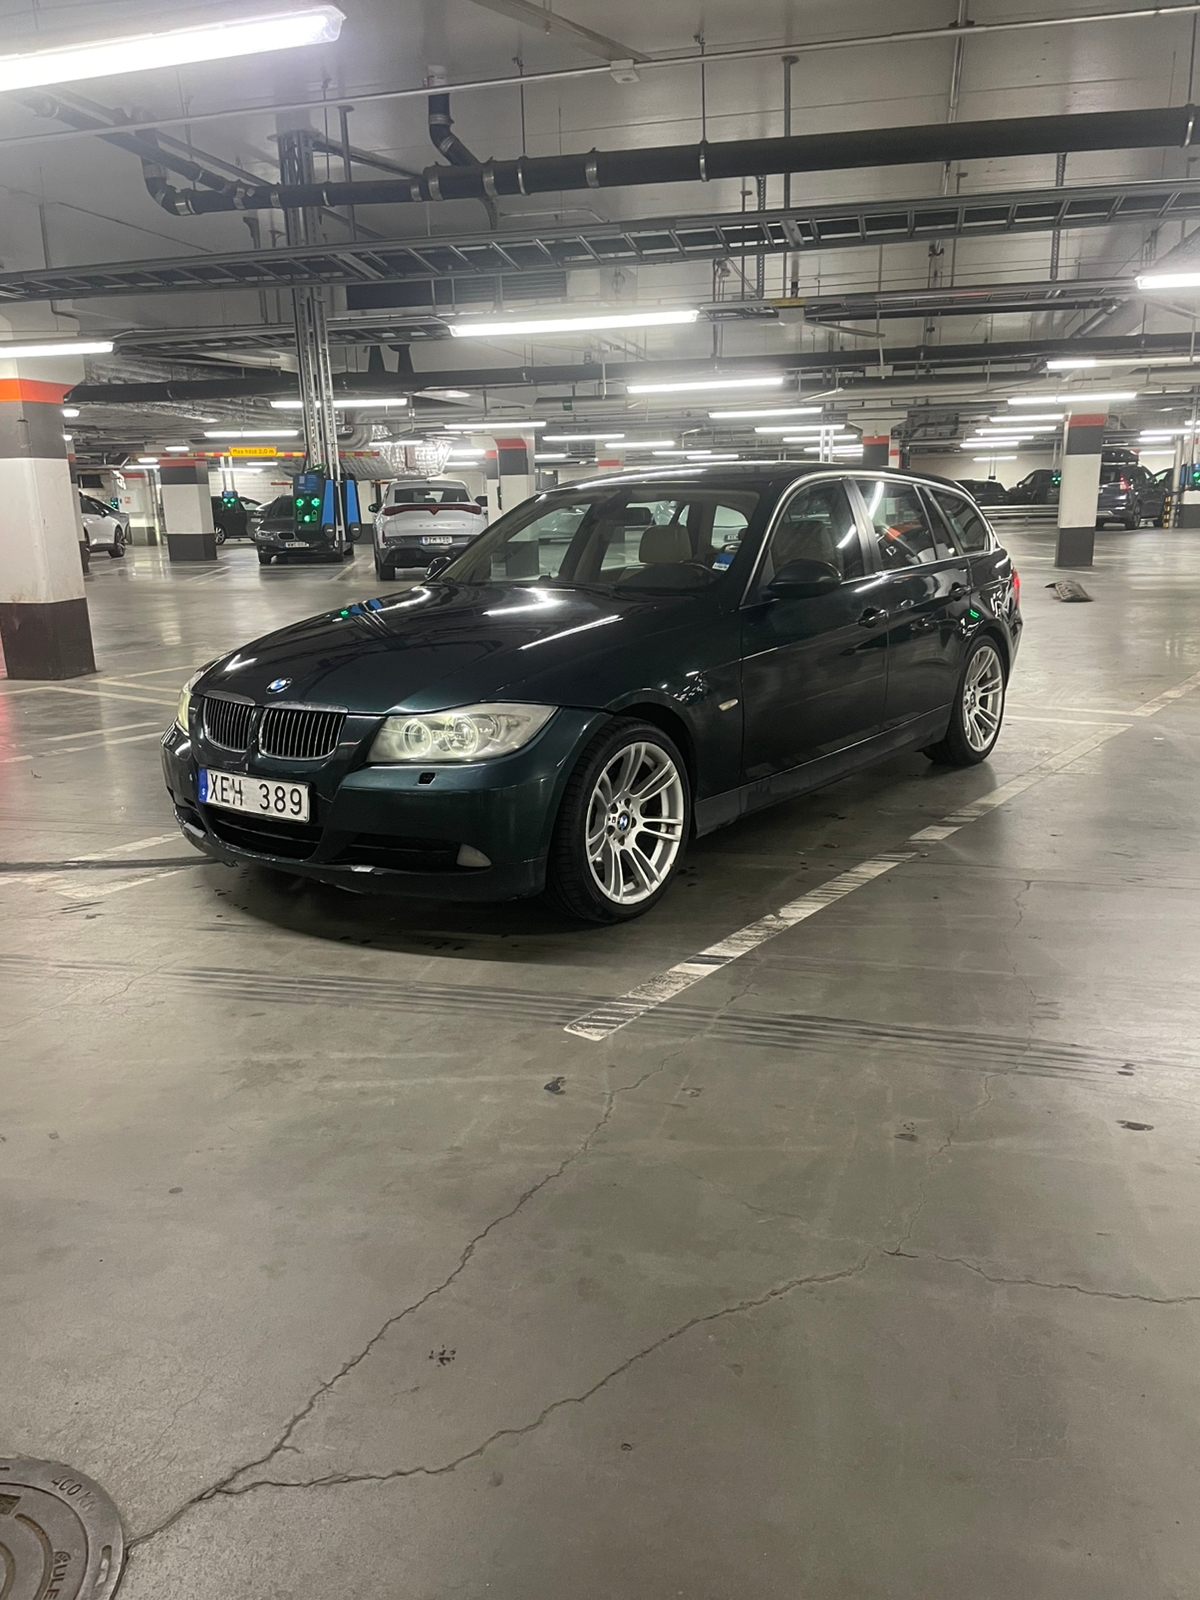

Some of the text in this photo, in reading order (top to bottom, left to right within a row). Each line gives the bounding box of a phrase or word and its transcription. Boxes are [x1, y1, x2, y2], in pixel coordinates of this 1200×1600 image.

[209, 773, 302, 816] XEH 389
[51, 1475, 82, 1496] 400
